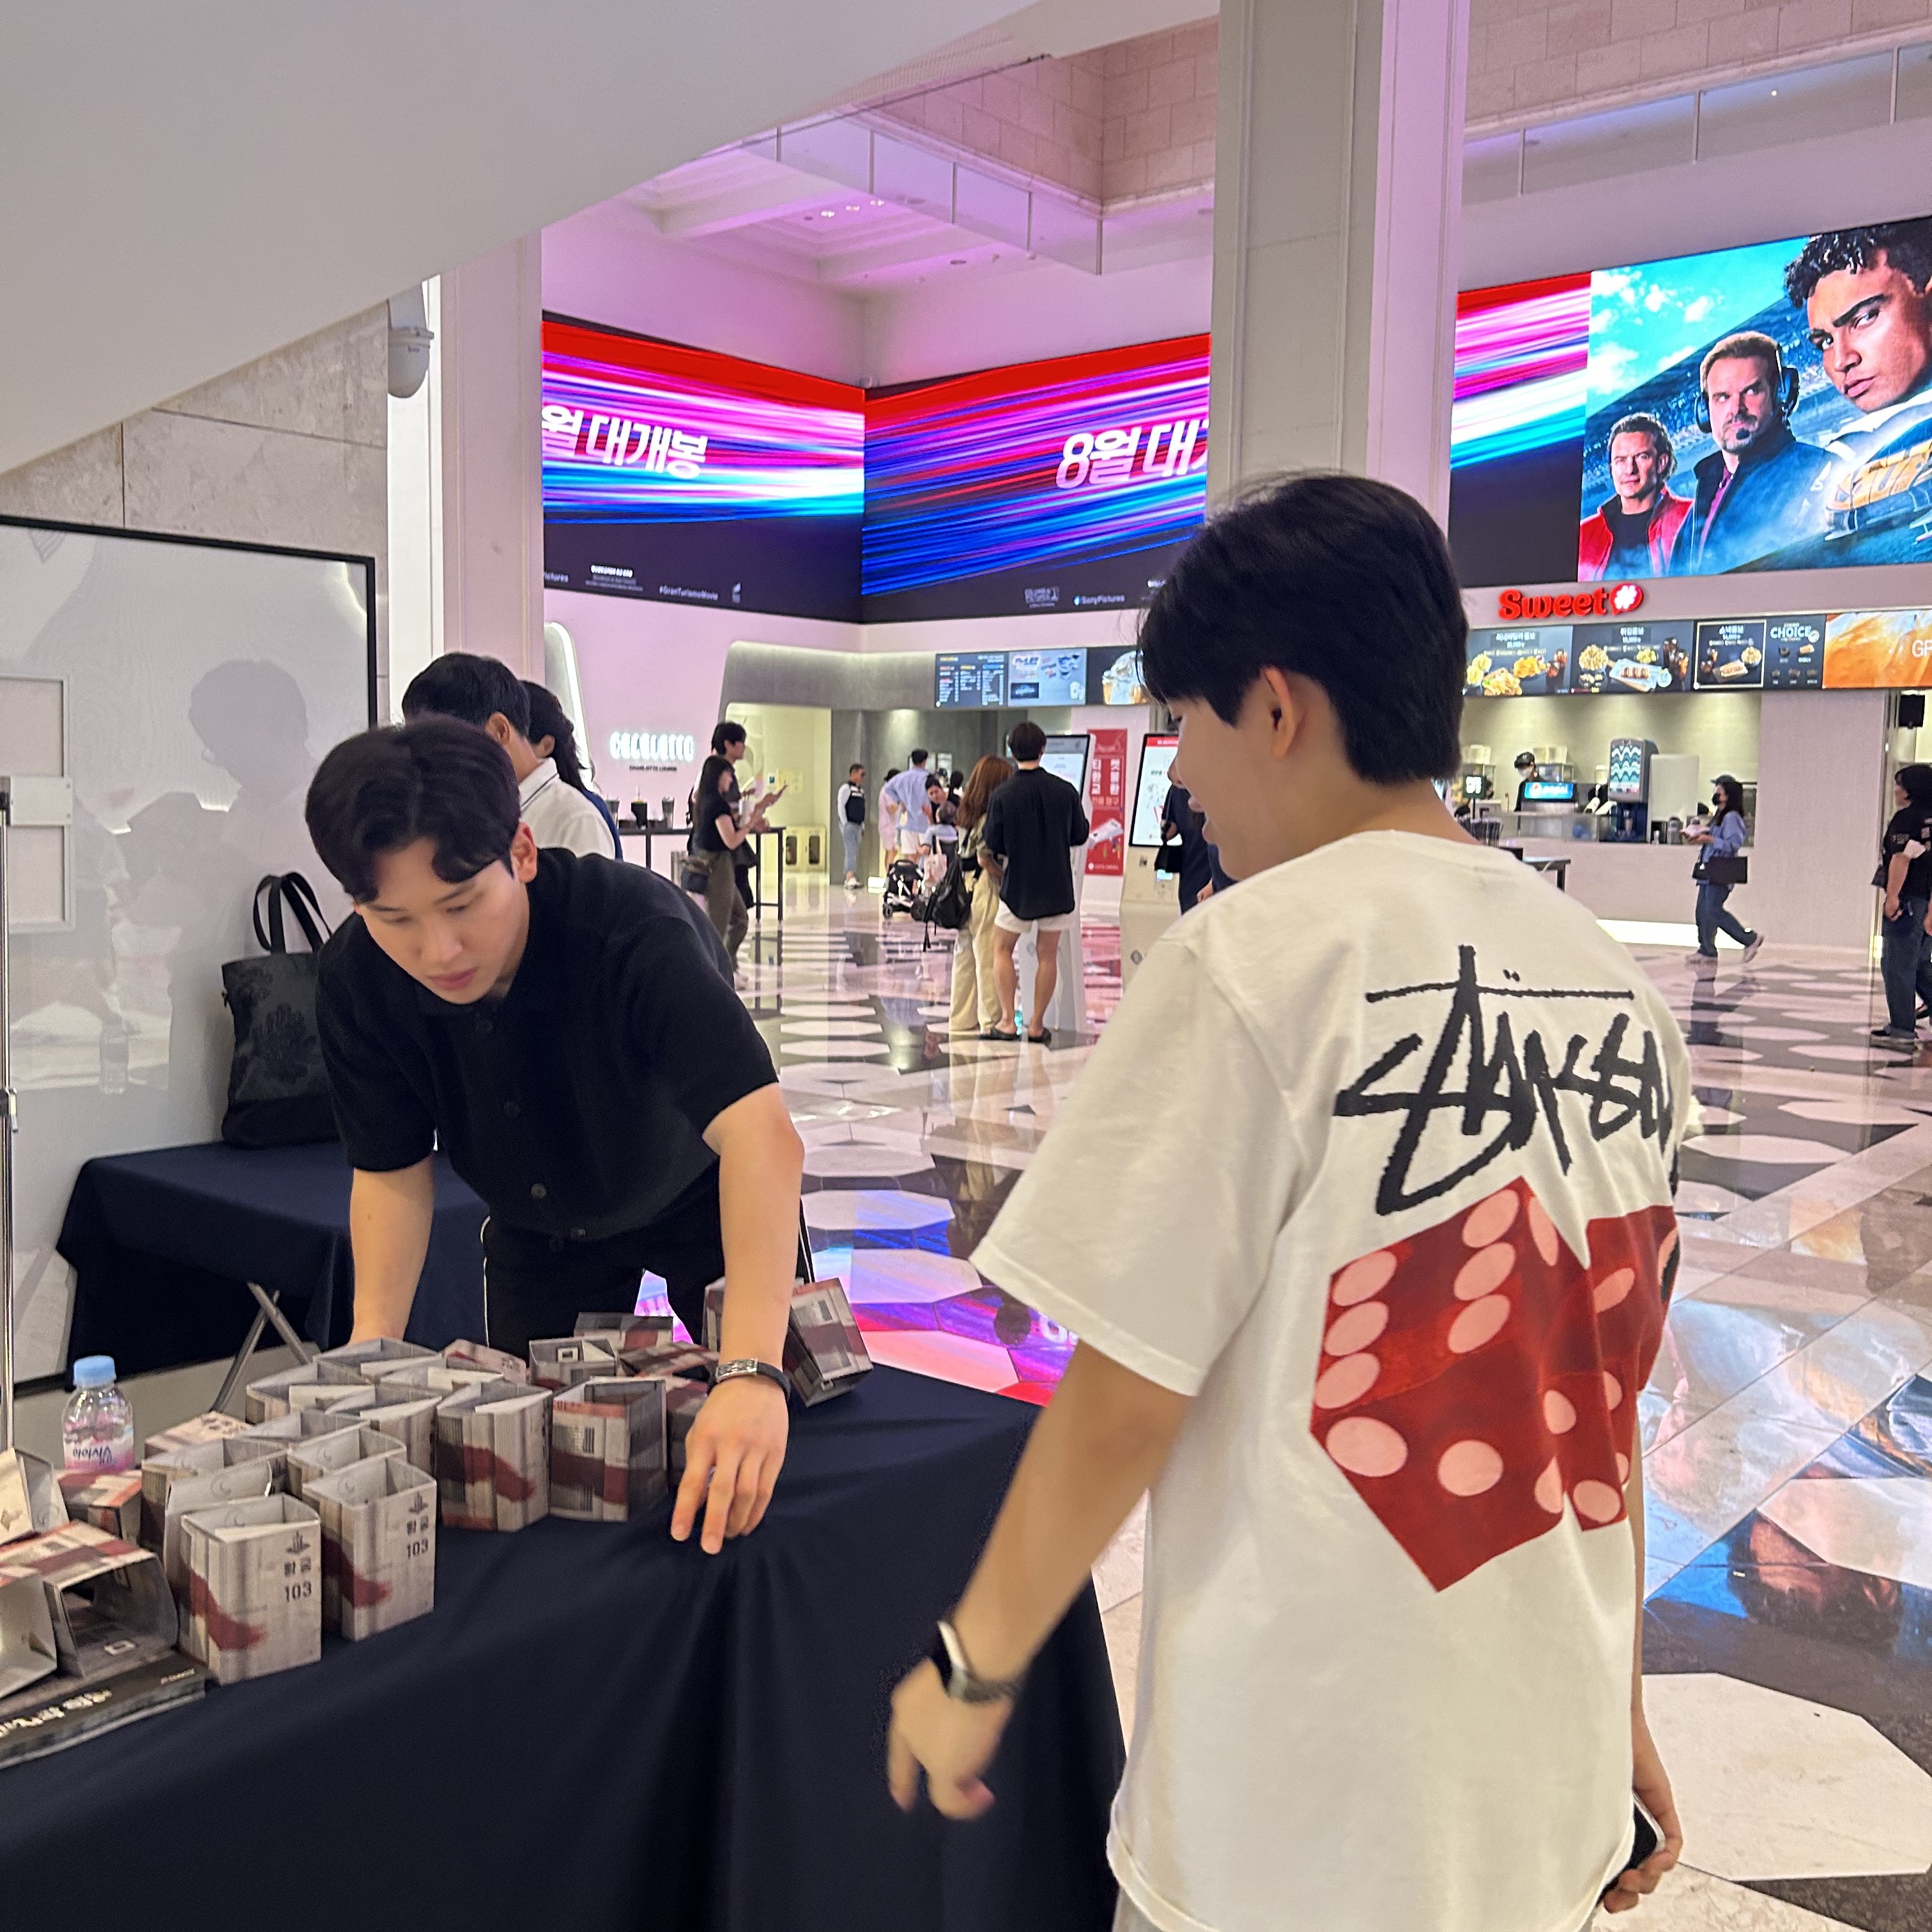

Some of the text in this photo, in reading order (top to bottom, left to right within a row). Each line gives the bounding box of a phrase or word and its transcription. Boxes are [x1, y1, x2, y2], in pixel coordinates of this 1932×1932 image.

[586, 414, 709, 479] 대개봉
[1055, 426, 1142, 489] 8월
[1770, 625, 1813, 640] CHOICE
[407, 1537, 429, 1560] 103
[285, 1579, 312, 1602] 103
